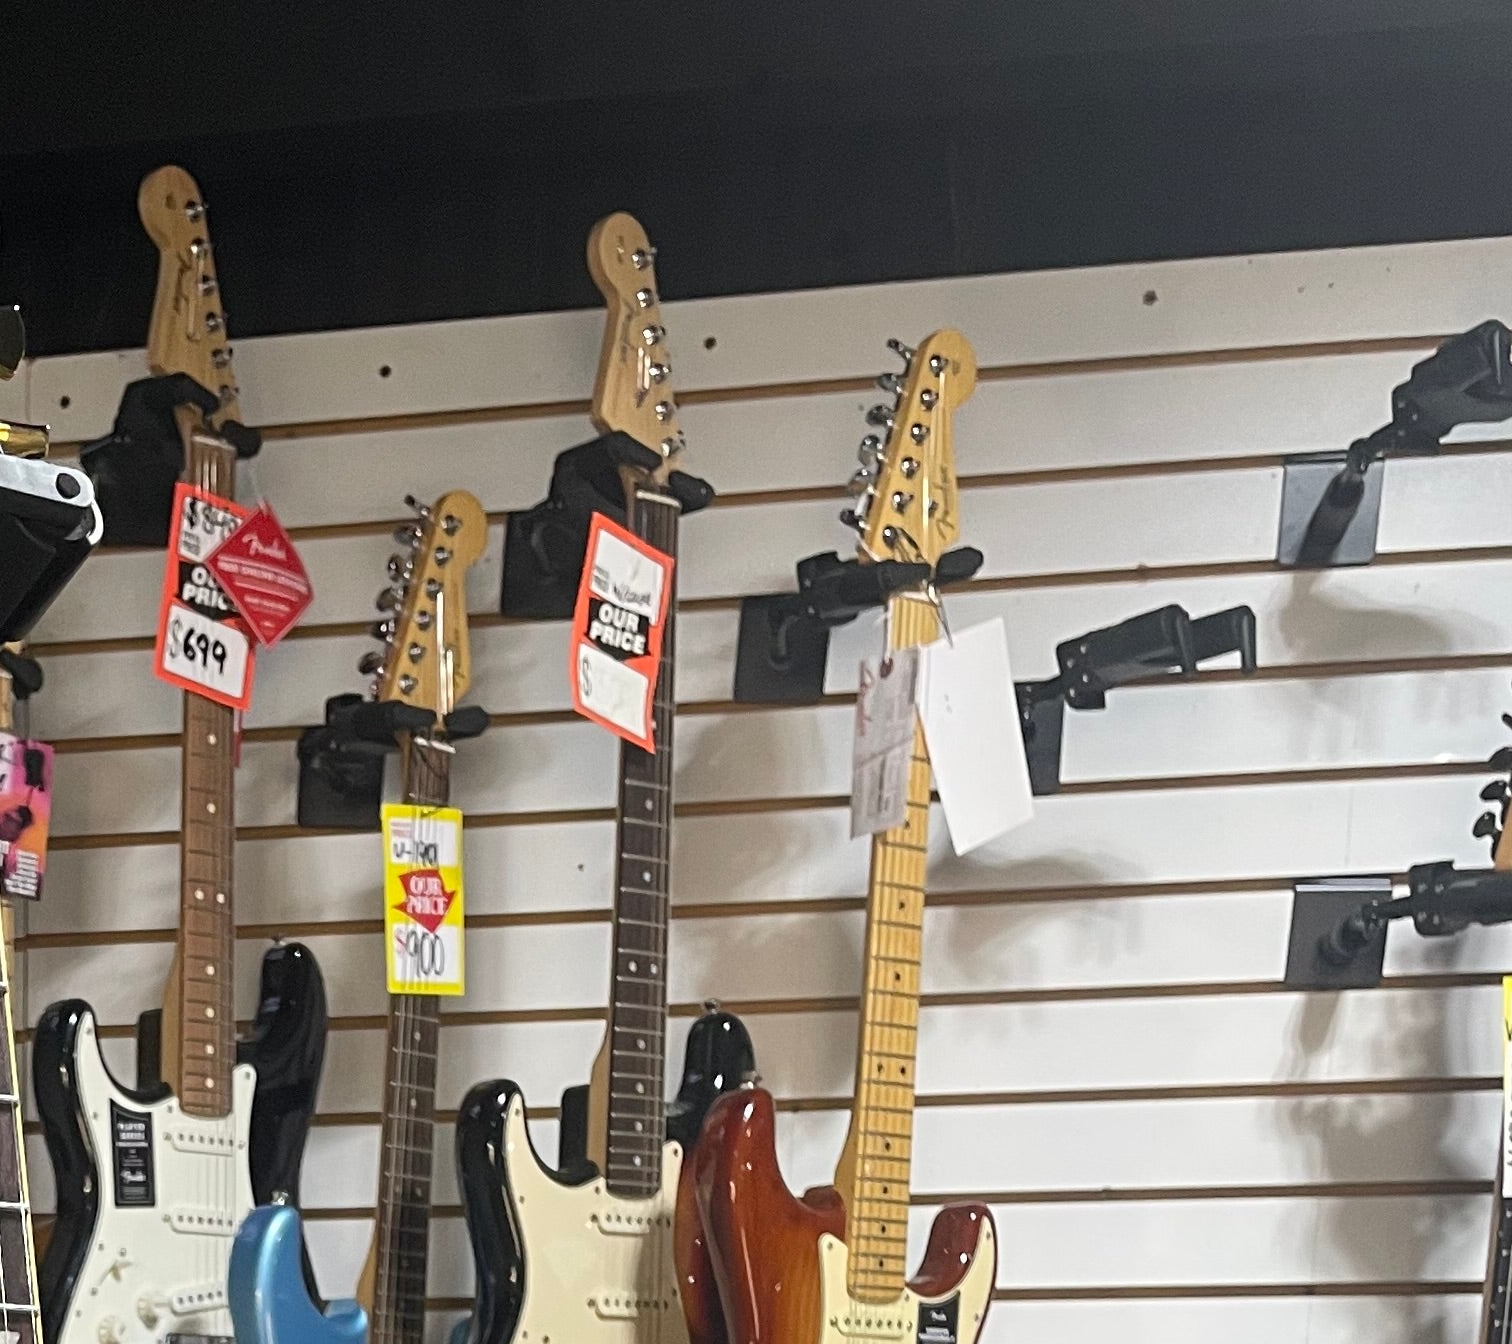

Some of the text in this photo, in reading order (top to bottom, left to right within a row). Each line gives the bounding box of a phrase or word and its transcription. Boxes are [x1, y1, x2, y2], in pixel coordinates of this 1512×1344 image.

[598, 602, 640, 634] OUR
[589, 619, 647, 656] PRICE
[408, 875, 443, 897] OUR
